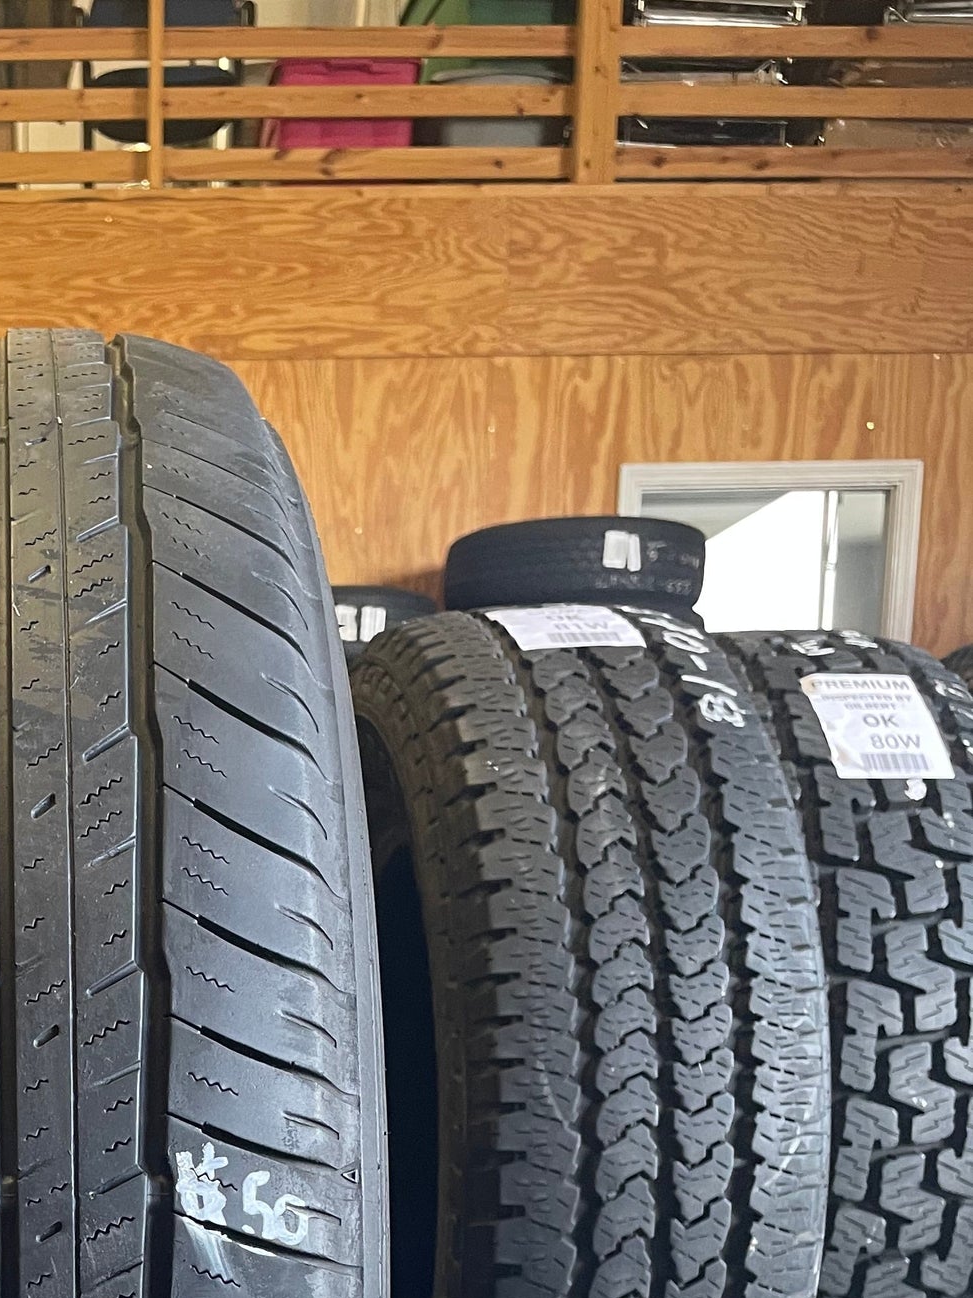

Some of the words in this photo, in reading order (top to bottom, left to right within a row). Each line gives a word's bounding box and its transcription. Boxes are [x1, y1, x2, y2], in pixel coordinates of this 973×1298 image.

[811, 679, 911, 691] PREMIUM
[863, 713, 900, 728] OK
[870, 733, 921, 750] 80W
